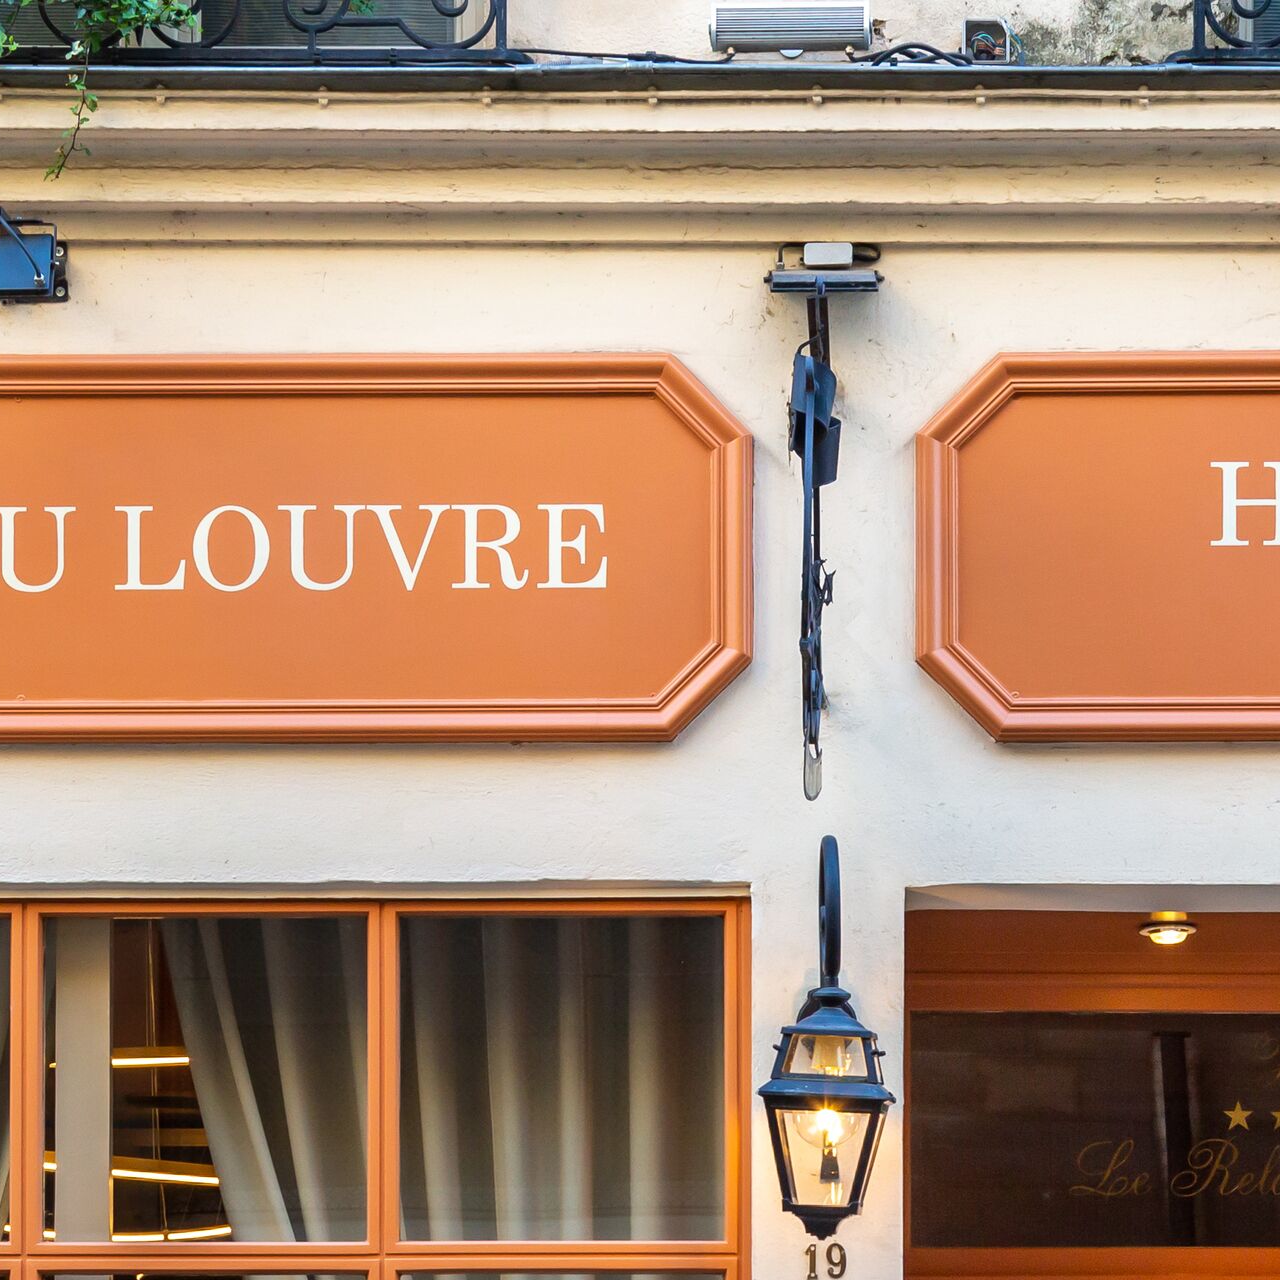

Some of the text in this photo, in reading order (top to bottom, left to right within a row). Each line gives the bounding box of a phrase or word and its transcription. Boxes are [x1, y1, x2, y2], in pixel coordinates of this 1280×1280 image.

[113, 502, 608, 592] LOUVRE
[1070, 1138, 1151, 1198] Le
[805, 1242, 847, 1280] 19
